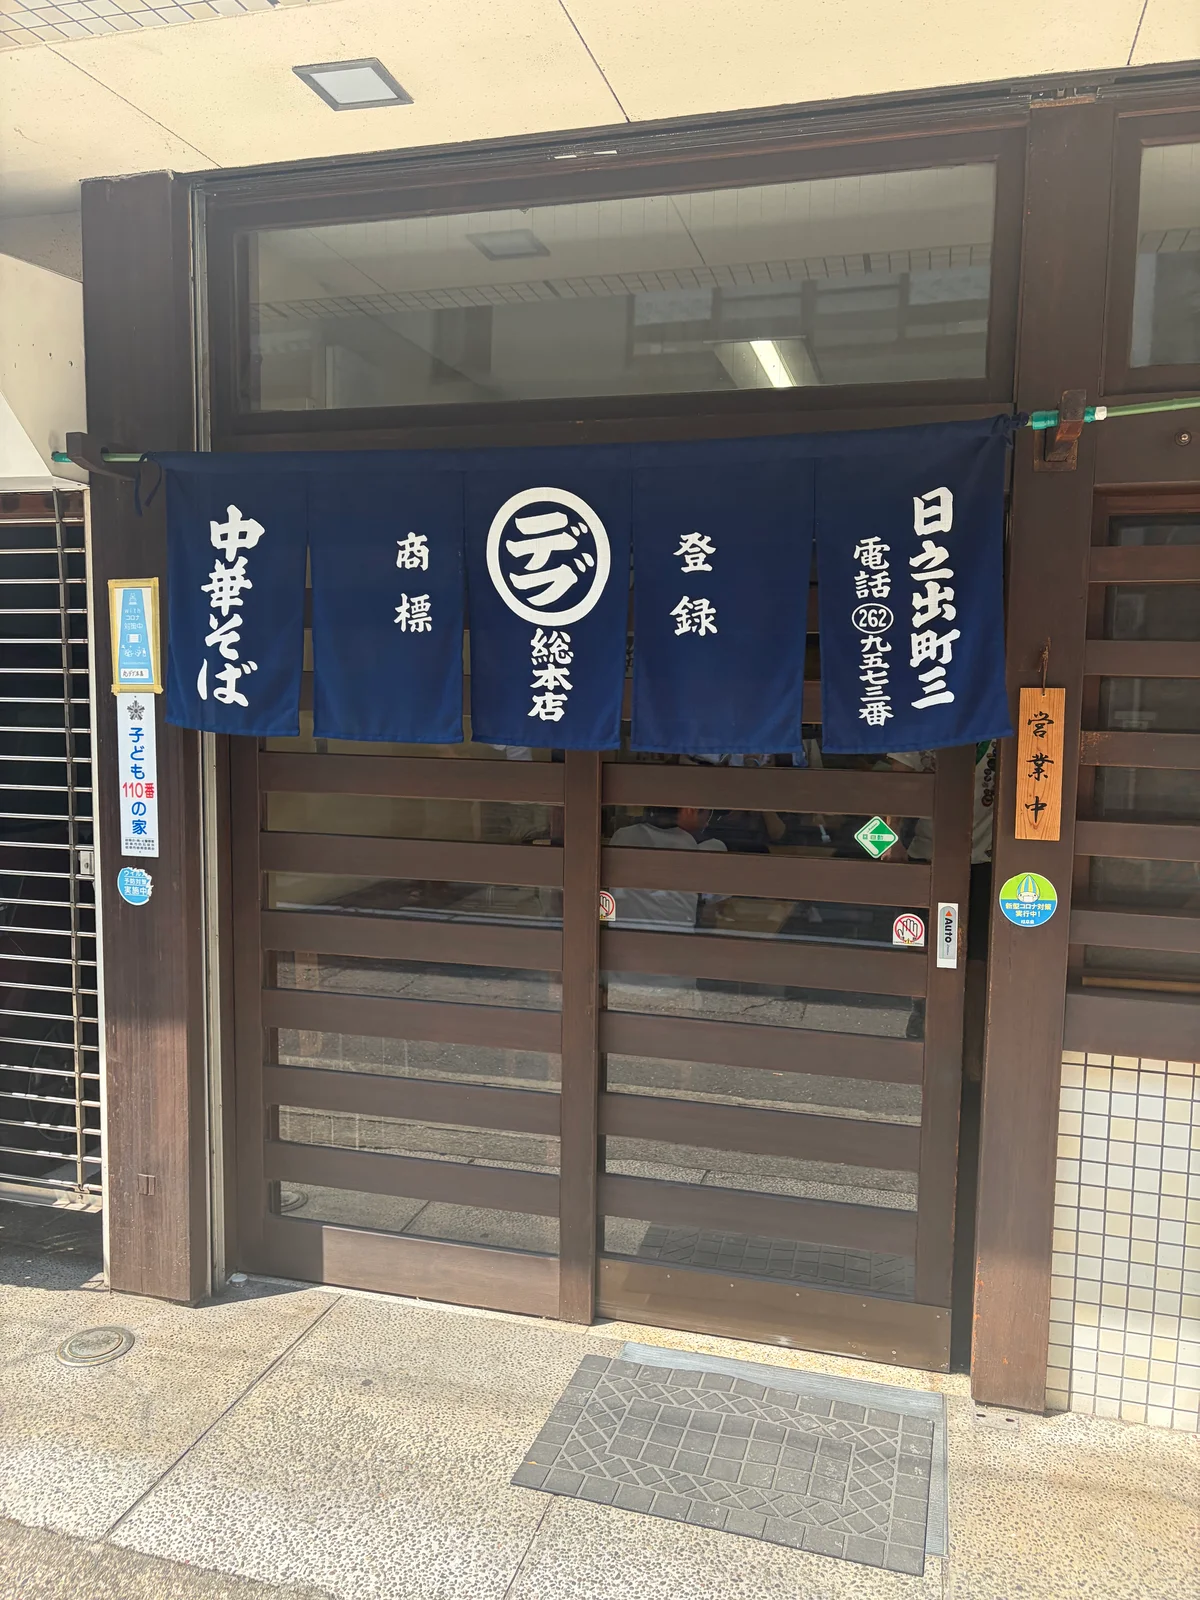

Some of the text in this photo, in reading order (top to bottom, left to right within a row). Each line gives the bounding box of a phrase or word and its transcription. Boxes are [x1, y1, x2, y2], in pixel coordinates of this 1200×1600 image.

[197, 504, 265, 707] 中華そば
[394, 531, 433, 633] 商標
[669, 531, 718, 637] 登録
[908, 486, 960, 709] 日之出町三
[528, 628, 574, 722] 総本店
[1025, 711, 1054, 823] 営業中
[945, 917, 953, 944] Auto
[1005, 902, 1052, 911] 新型コロナ対策
